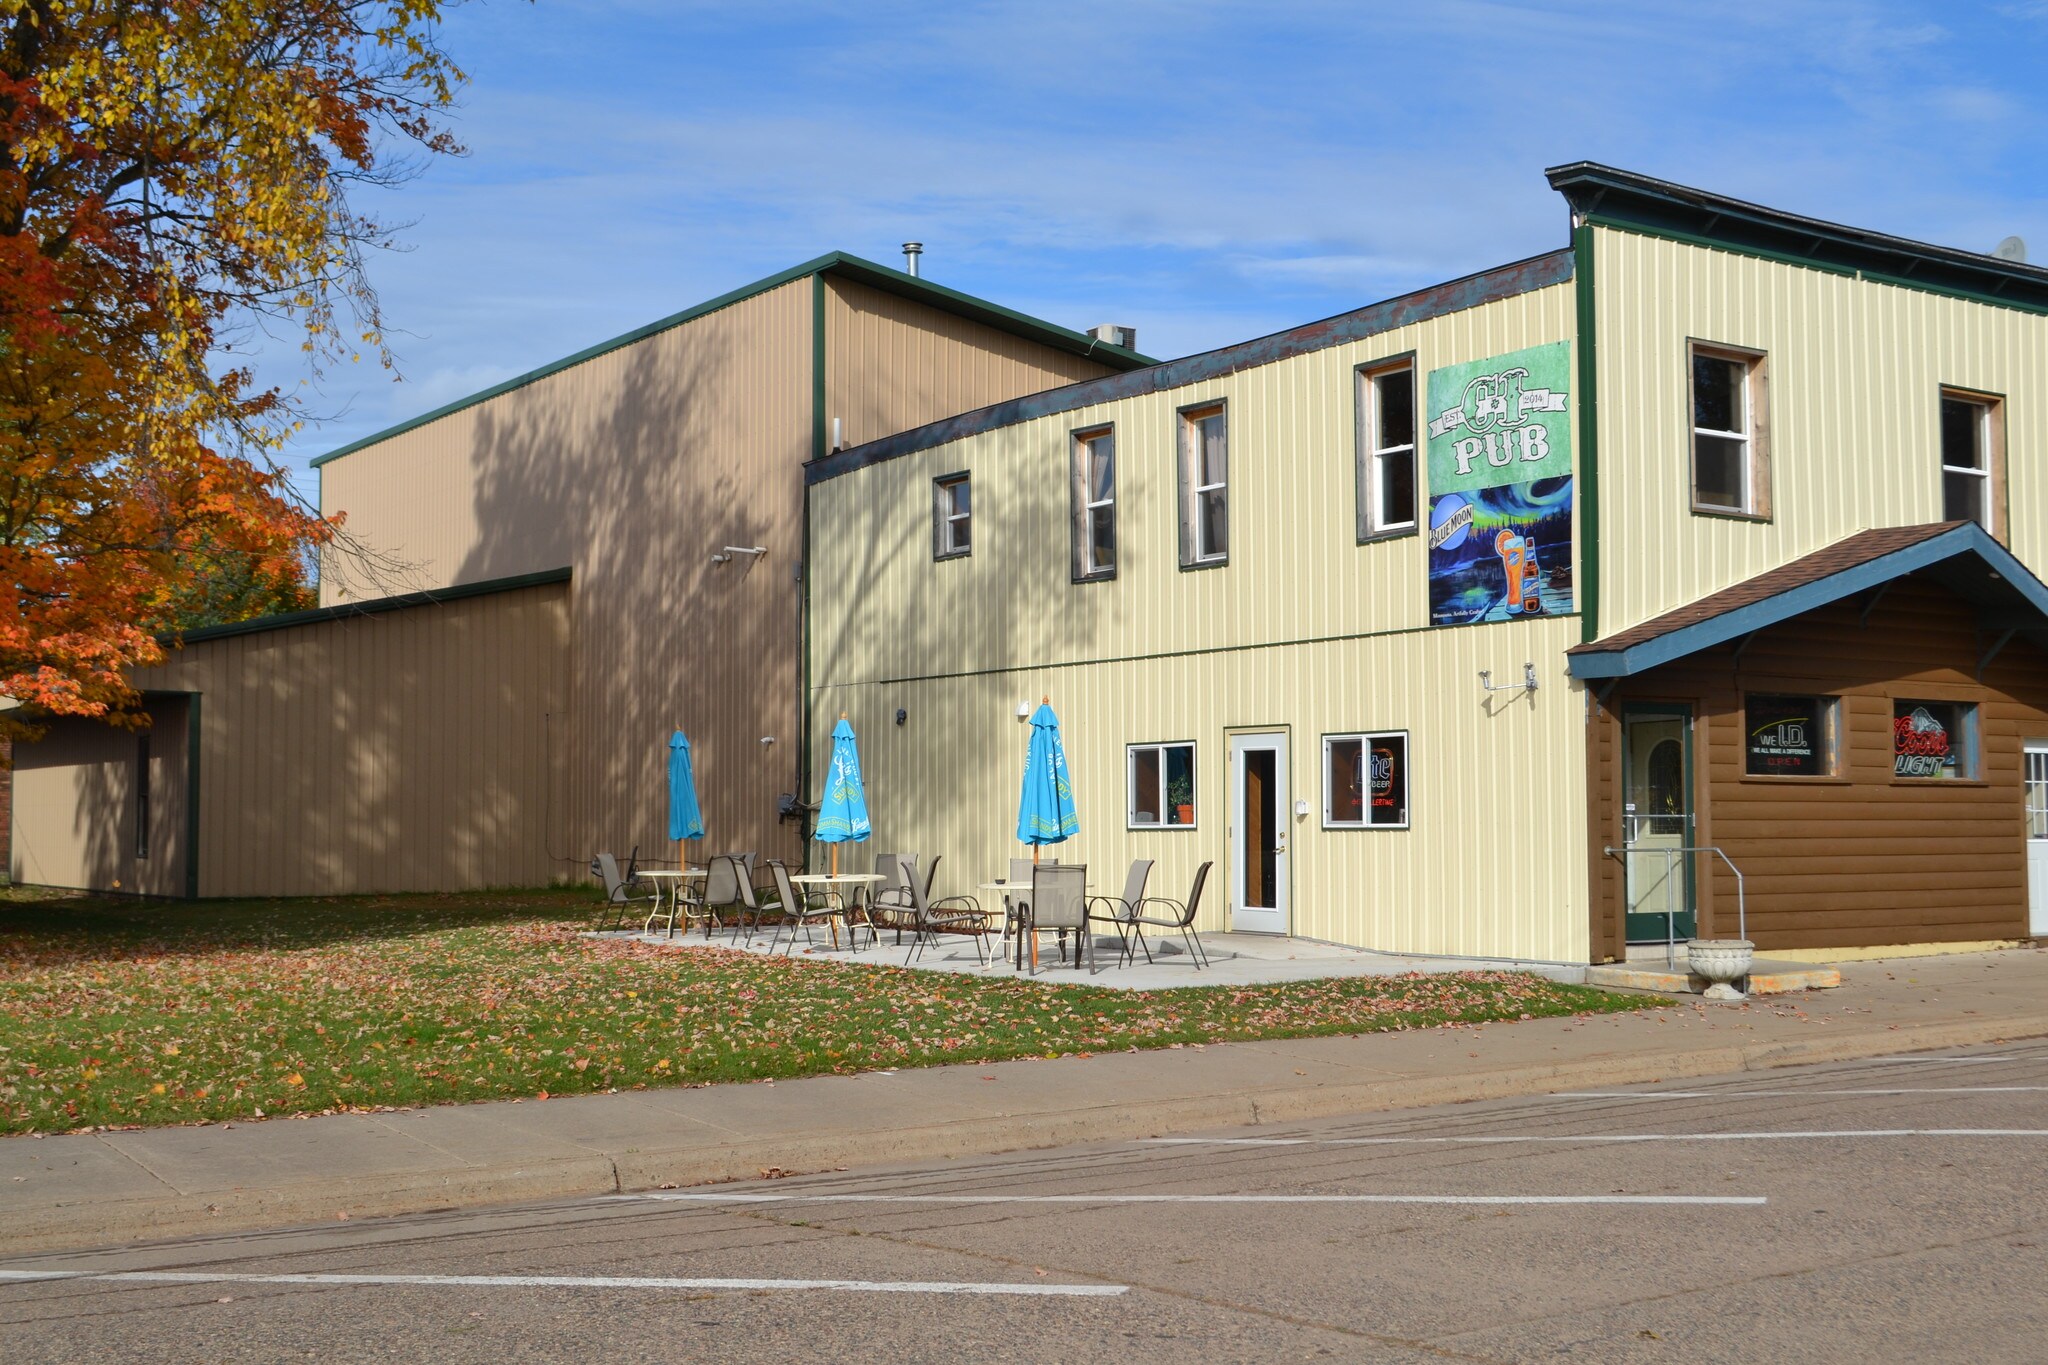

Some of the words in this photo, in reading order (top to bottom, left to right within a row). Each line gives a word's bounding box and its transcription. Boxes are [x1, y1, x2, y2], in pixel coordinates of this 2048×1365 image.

[1524, 394, 1543, 404] 2014
[1451, 423, 1550, 475] PUB
[1429, 522, 1450, 550] BLUE
[1450, 507, 1472, 532] MOON
[1760, 735, 1777, 746] WE
[1356, 754, 1391, 784] Lte
[1895, 755, 1945, 774] LIGHT
